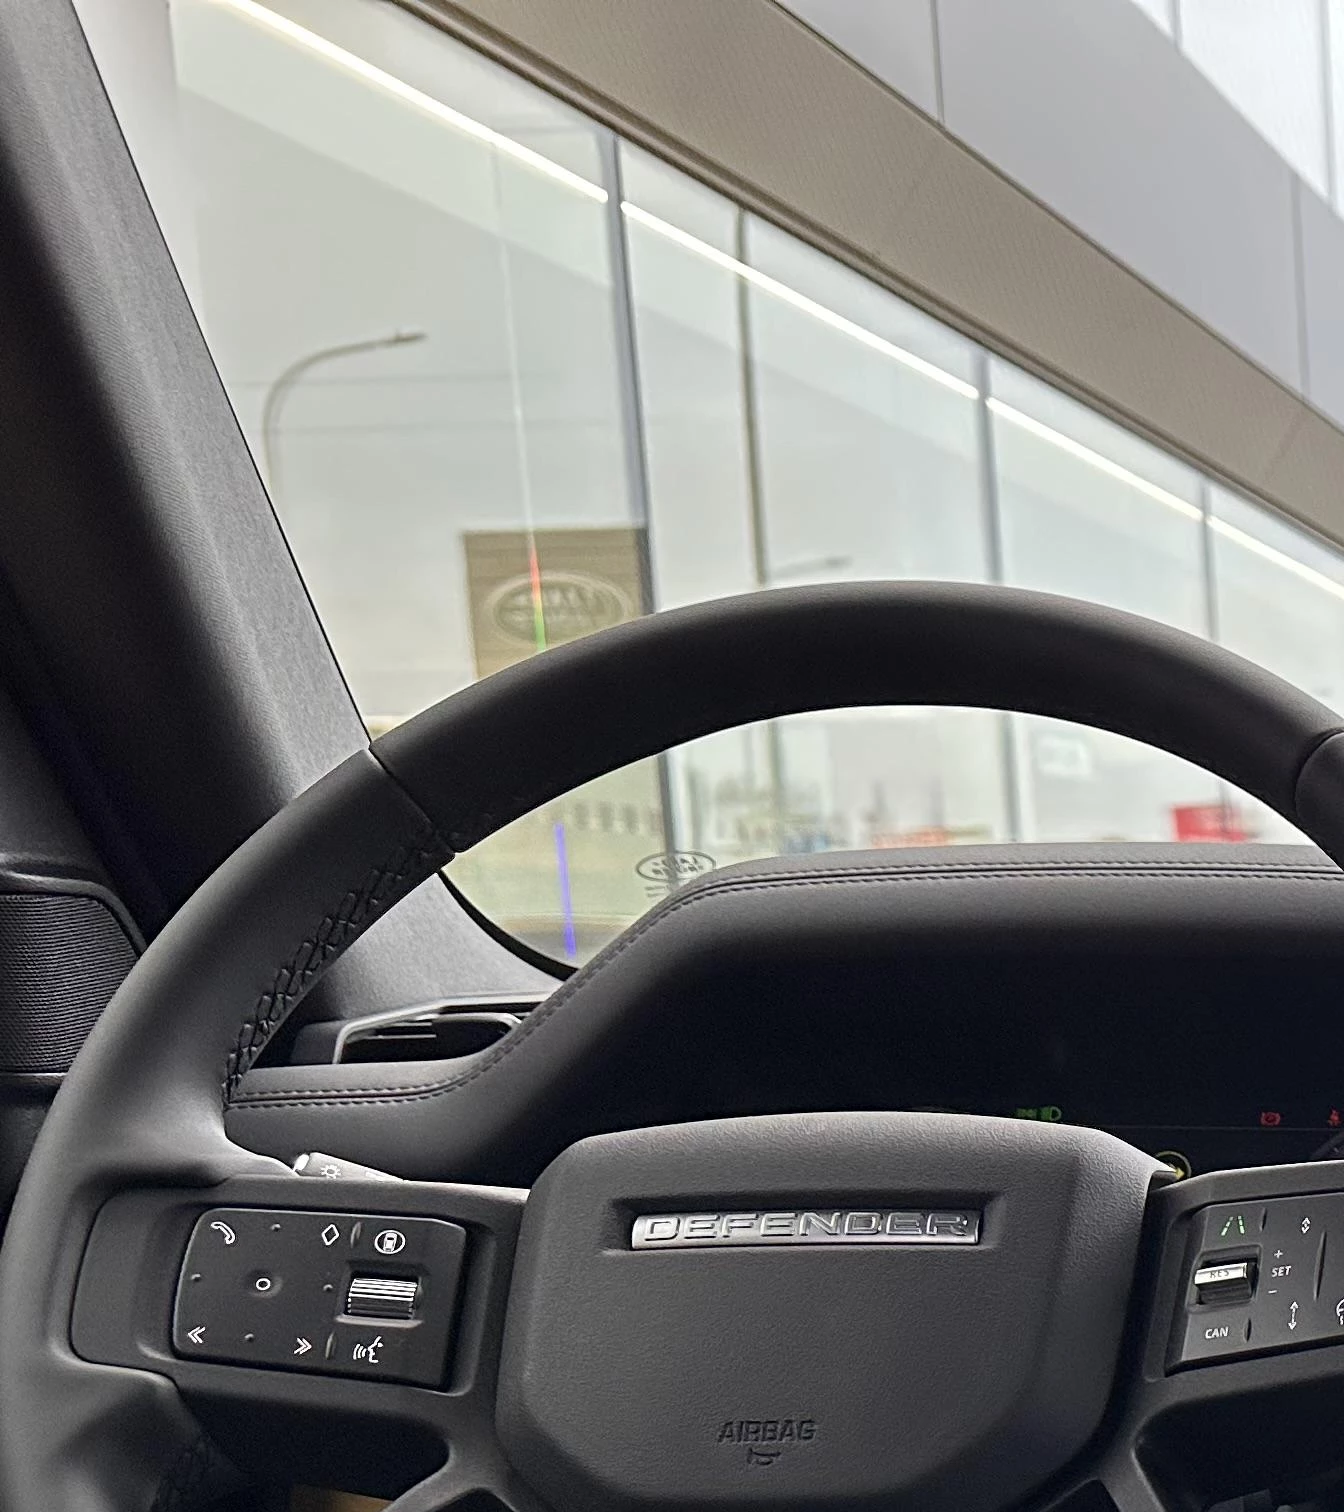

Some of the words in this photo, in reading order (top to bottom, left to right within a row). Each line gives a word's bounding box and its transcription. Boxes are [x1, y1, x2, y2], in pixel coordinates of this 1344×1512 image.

[643, 1210, 970, 1242] DEFENDER
[1208, 1268, 1231, 1279] RES
[1271, 1266, 1292, 1278] SET
[1205, 1326, 1229, 1339] CAN
[716, 1418, 818, 1445] AIRBAG
